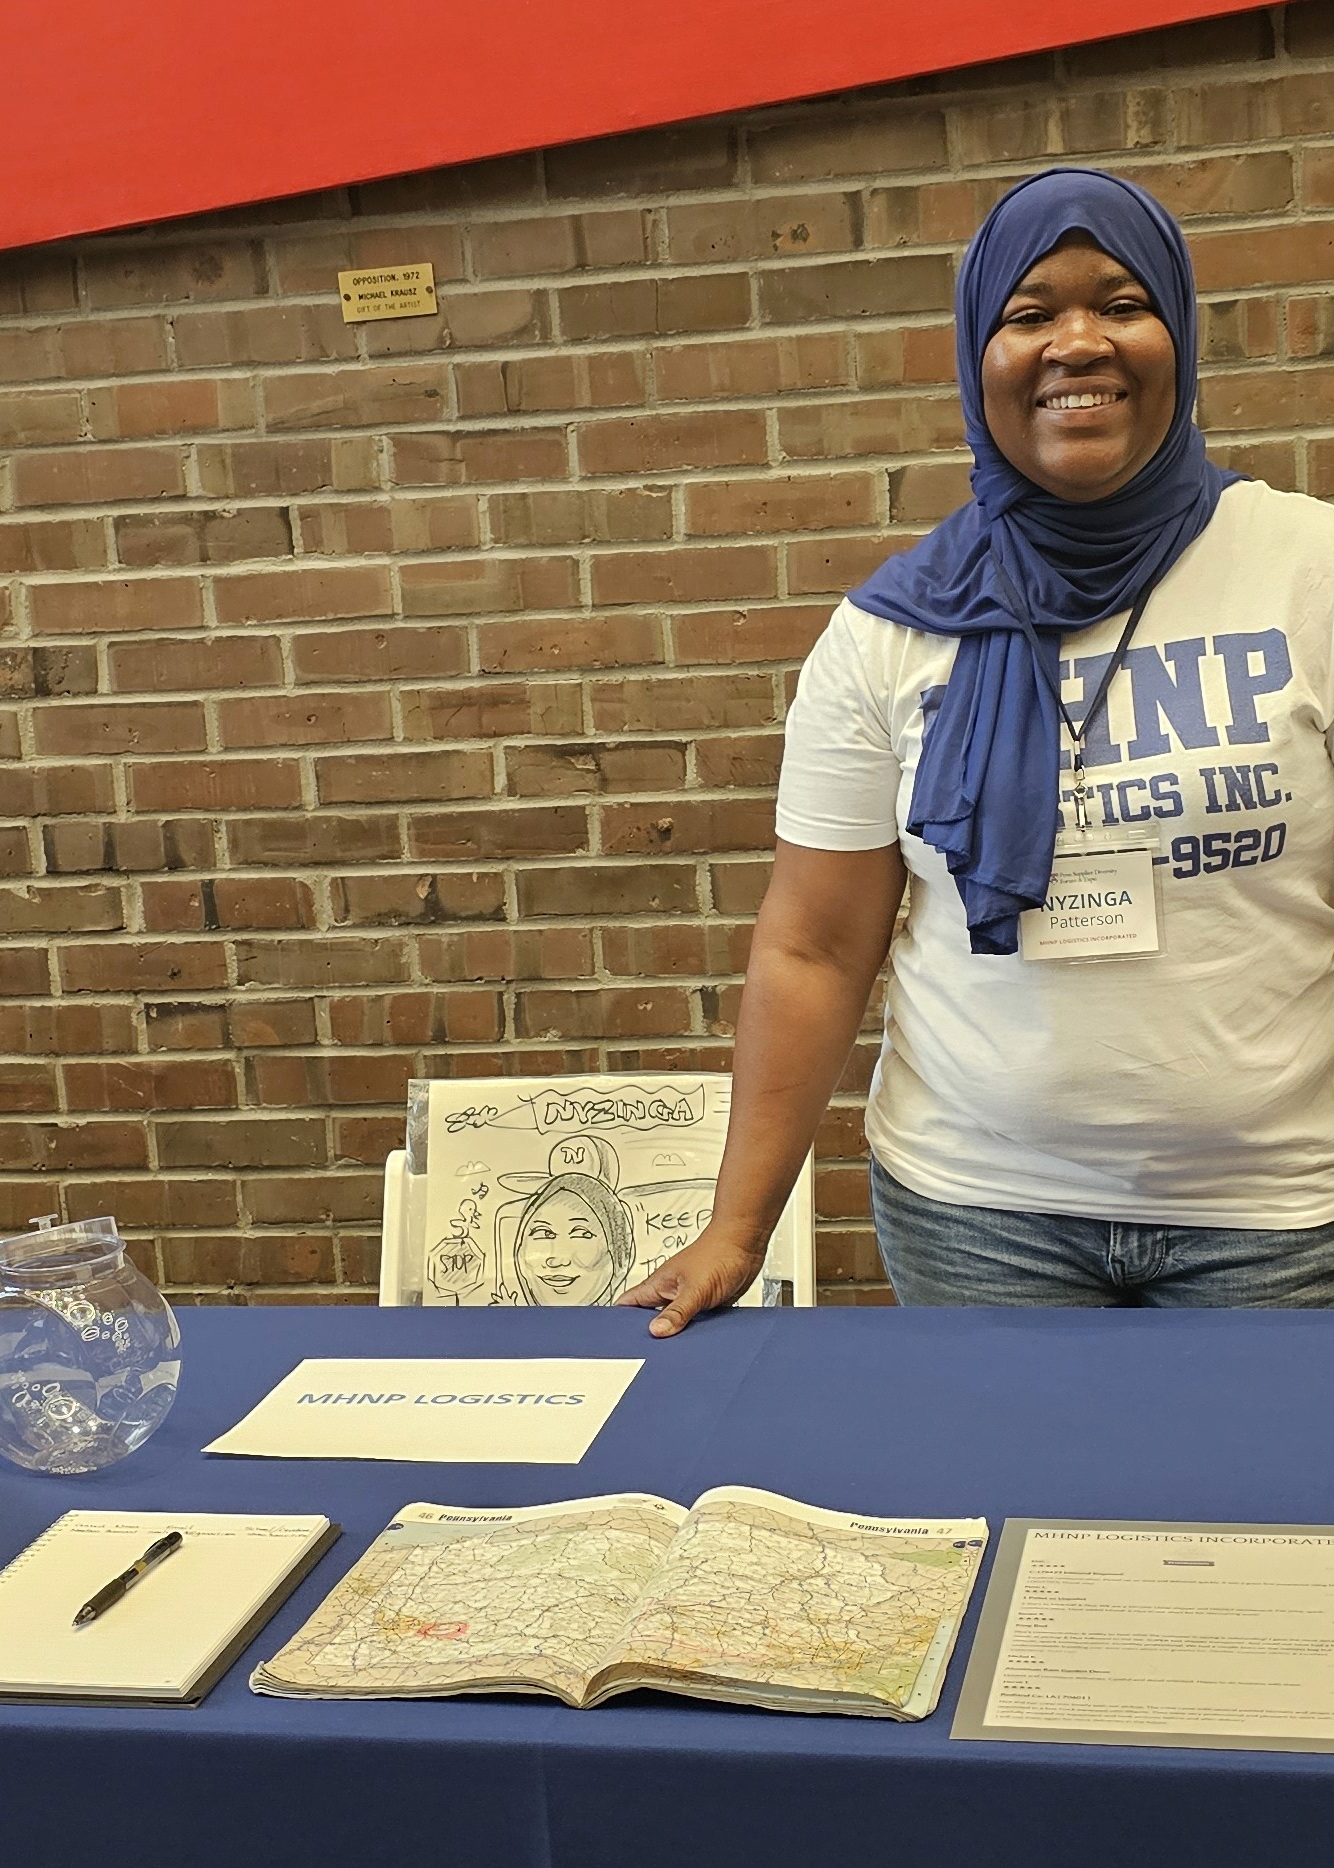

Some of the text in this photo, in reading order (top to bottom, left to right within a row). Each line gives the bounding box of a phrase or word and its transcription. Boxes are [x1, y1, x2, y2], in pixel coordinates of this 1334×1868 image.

[402, 271, 420, 281] 1972
[358, 291, 387, 301] MICHAEL
[356, 305, 370, 314] GIFT
[384, 303, 396, 311] THE
[399, 300, 420, 309] ARTIST
[919, 627, 1294, 772] HNP
[1199, 762, 1293, 814] INC.
[1151, 822, 1287, 880] -9520
[1040, 890, 1133, 912] NYZINGA
[1050, 913, 1124, 930] Patterson
[1059, 936, 1089, 945] LOGISTICS
[1089, 933, 1137, 942] INCORPORATED
[543, 1098, 694, 1125] NYZINGA
[560, 1146, 585, 1164] N
[662, 1233, 688, 1249] ON
[439, 1253, 473, 1274] STOP
[297, 1393, 586, 1405] MHNP LOGISTICS
[417, 1512, 513, 1523] 46 Pennsylvania
[849, 1521, 929, 1535] Pennsylvania
[1034, 1532, 1092, 1540] MHNP
[1095, 1533, 1193, 1543] LOGISTICS
